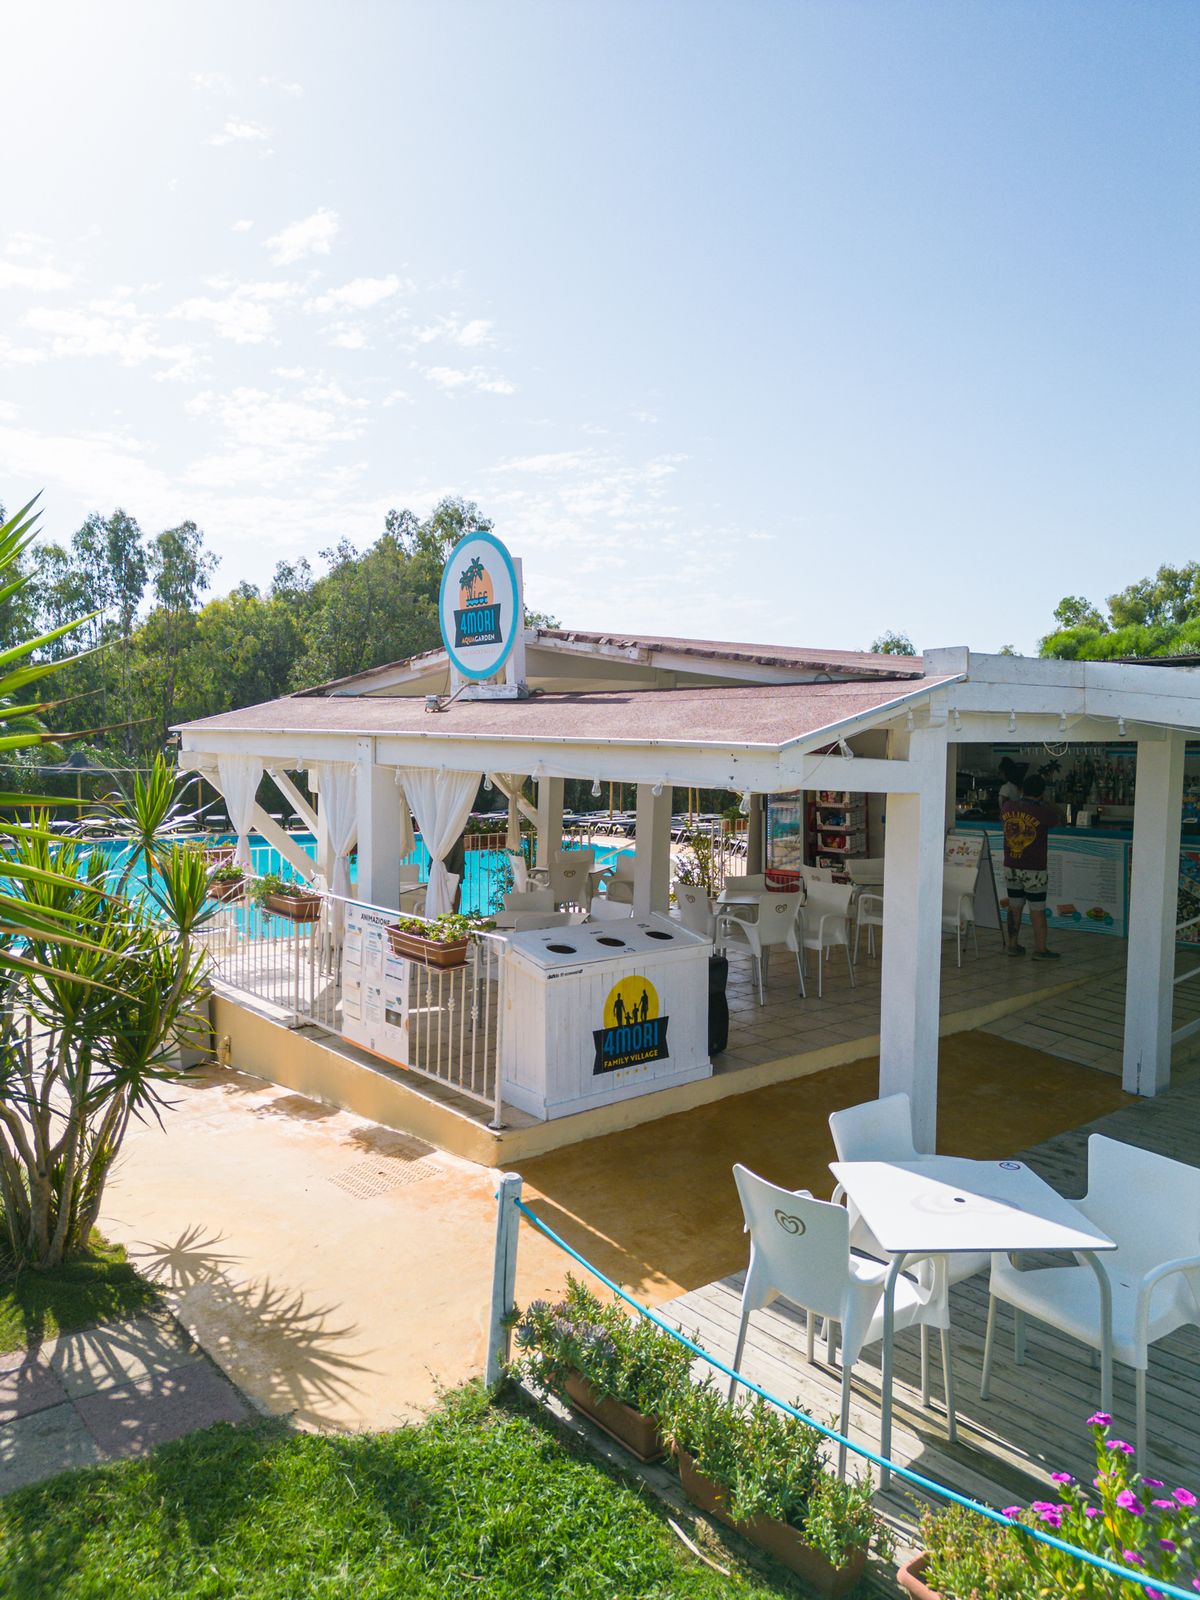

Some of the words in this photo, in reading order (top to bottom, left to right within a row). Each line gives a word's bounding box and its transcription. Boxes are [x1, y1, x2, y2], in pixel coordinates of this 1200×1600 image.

[461, 609, 495, 634] 4MORI
[361, 913, 390, 925] ANIMAZIONE
[604, 1022, 659, 1056] 4MORI
[604, 1056, 629, 1068] FAMILY
[630, 1050, 659, 1062] VILLAGE
